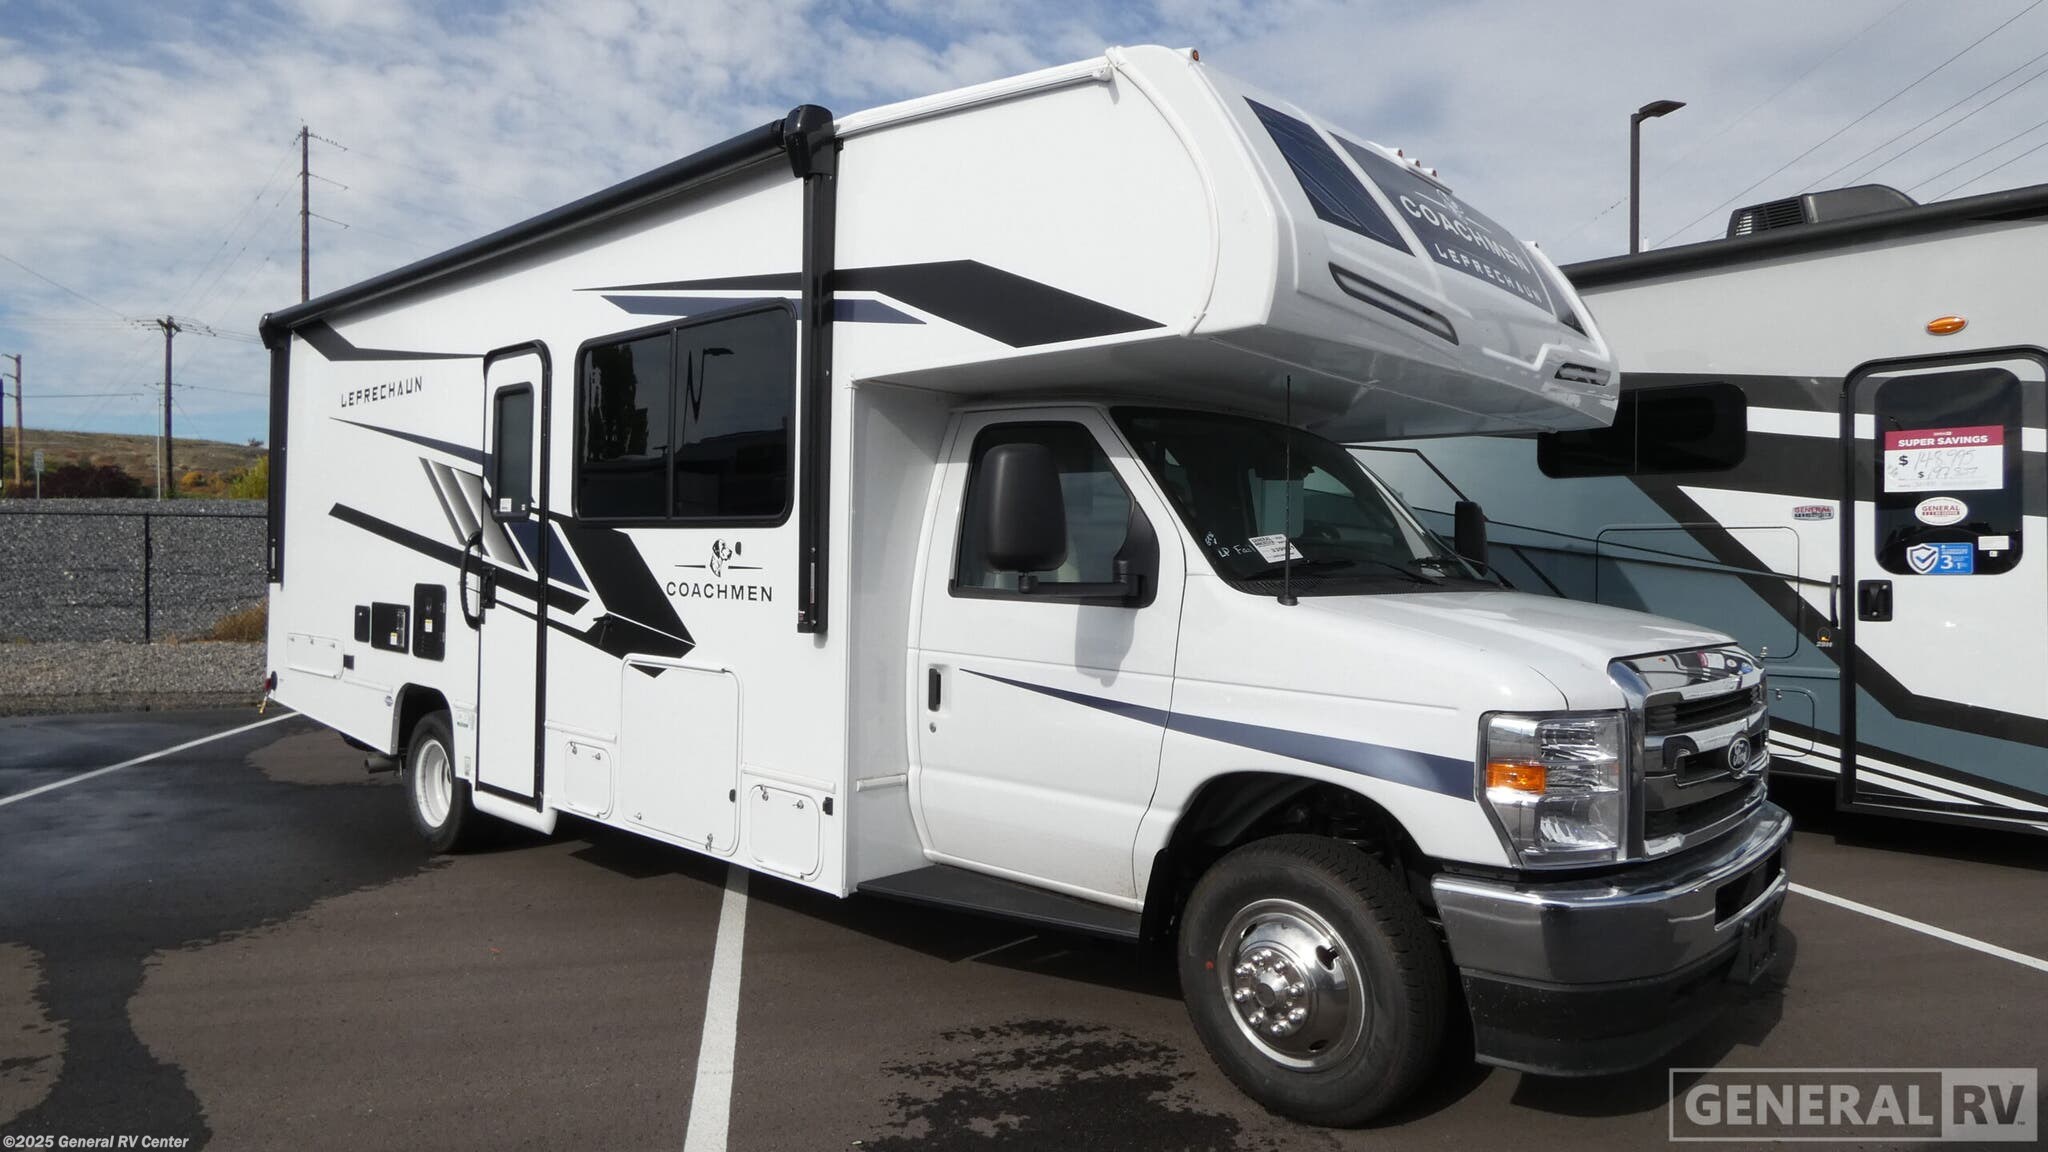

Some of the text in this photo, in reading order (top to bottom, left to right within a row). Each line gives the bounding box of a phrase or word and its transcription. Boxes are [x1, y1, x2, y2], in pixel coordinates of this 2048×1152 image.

[1400, 195, 1530, 275] COACHMEN
[1434, 243, 1543, 304] LEPRECHAUN
[341, 376, 422, 408] LEPRECHAUN
[1898, 435, 1988, 447] SUPER SAVINGS
[1941, 555, 1953, 569] 3
[666, 581, 772, 602] COACHMEN
